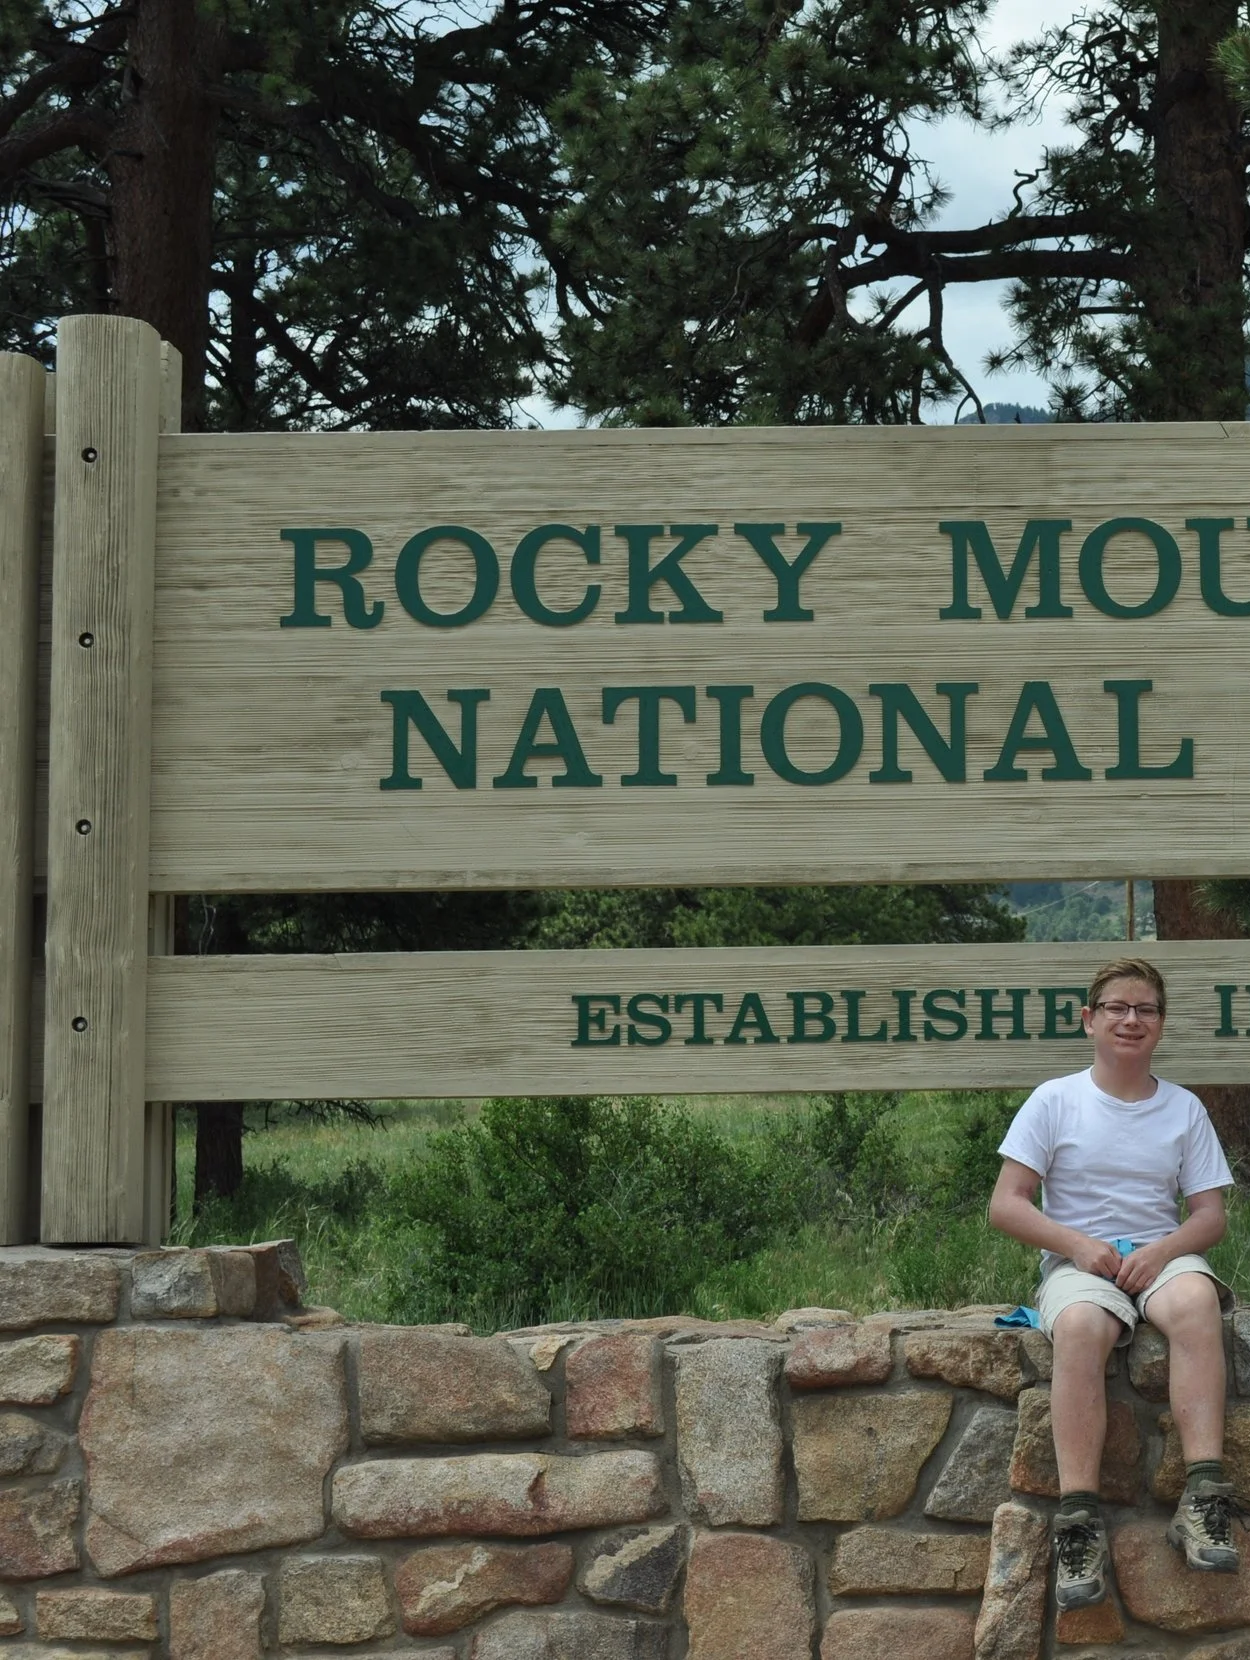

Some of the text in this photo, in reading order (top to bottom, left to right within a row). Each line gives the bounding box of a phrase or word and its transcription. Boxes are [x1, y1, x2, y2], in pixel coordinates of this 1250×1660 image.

[280, 521, 842, 630] ROCKY
[379, 679, 1195, 791] NATIONAL
[570, 986, 1088, 1048] ESTABLISHE
